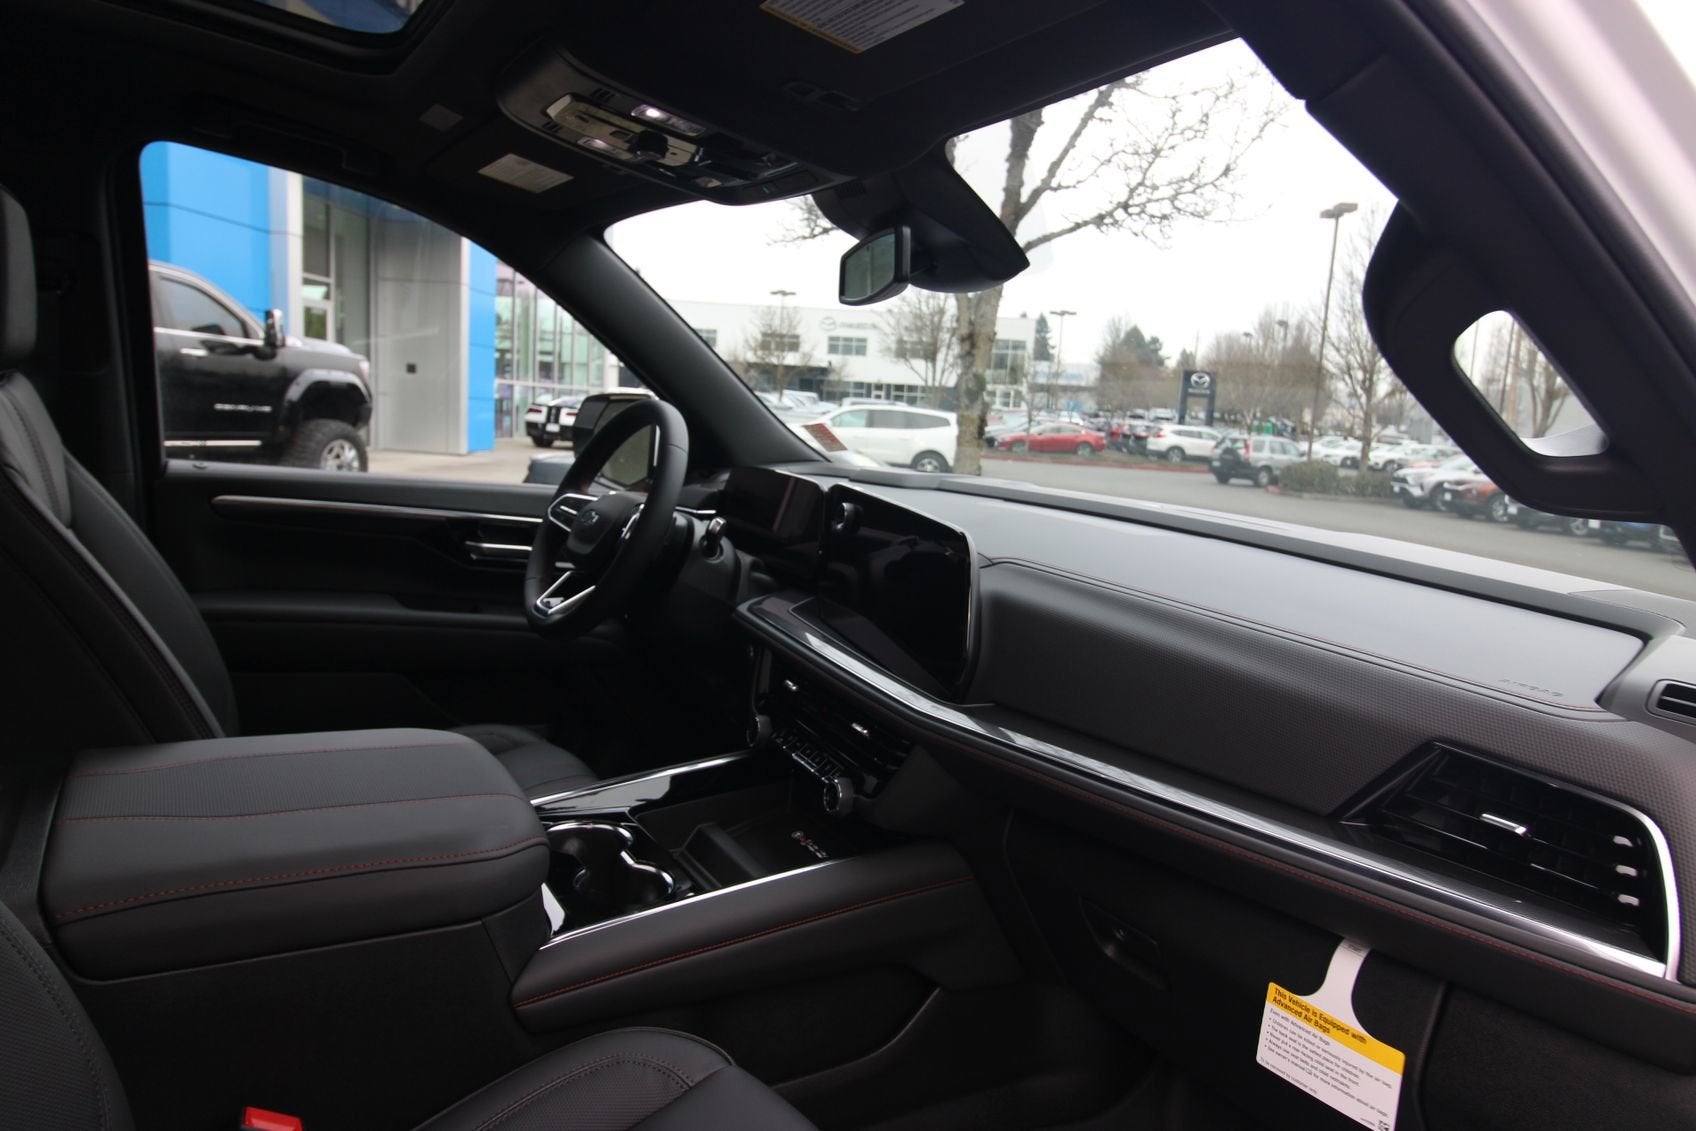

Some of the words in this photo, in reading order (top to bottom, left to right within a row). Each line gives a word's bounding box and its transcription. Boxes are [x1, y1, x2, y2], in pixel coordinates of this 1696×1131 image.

[1272, 996, 1302, 1017] Advanced
[1304, 1014, 1312, 1023] Air
[1313, 1020, 1330, 1034] Bags
[1274, 989, 1287, 999] This
[1288, 996, 1310, 1013] Vehicle
[1318, 1014, 1349, 1036] Equipped
[1351, 1032, 1367, 1044] with
